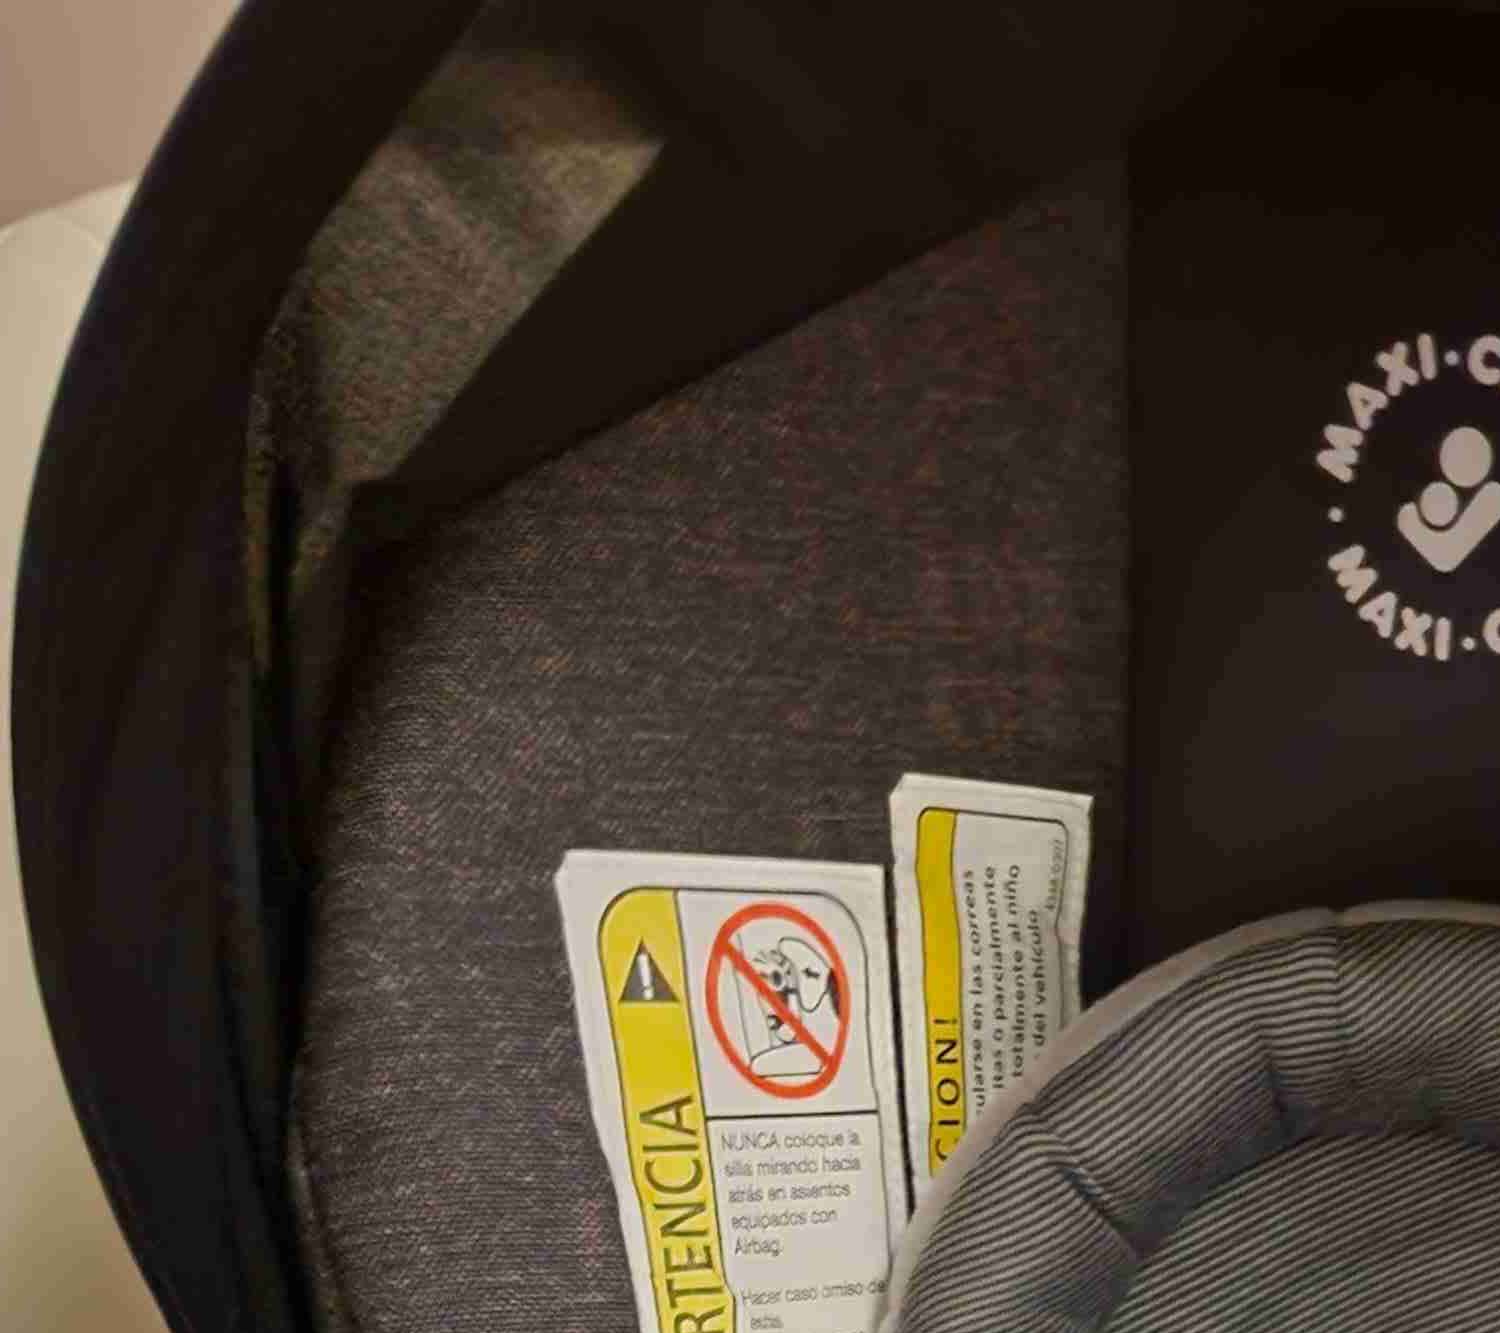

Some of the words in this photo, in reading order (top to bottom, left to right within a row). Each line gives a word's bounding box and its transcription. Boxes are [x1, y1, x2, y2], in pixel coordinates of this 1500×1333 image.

[1003, 864, 1020, 915] niño
[963, 869, 981, 957] correas
[983, 866, 1007, 1021] parcialmente
[1007, 923, 1021, 942] al
[1027, 908, 1047, 1006] vehículo
[970, 963, 983, 996] las
[973, 1002, 982, 1030] en
[1011, 948, 1025, 1078] totalmente
[1032, 1012, 1046, 1048] del
[721, 1131, 780, 1151] NUNCA
[784, 1132, 844, 1151] coloque
[757, 1158, 818, 1175] mirando
[823, 1157, 861, 1173] hacia
[729, 1184, 764, 1202] atrás
[768, 1188, 787, 1200] en
[790, 1183, 850, 1200] asientos
[732, 1212, 808, 1231] equipados
[811, 1209, 838, 1225] con
[743, 1291, 782, 1307] Hacer
[785, 1289, 817, 1303] caso
[821, 1280, 864, 1298] omiso
